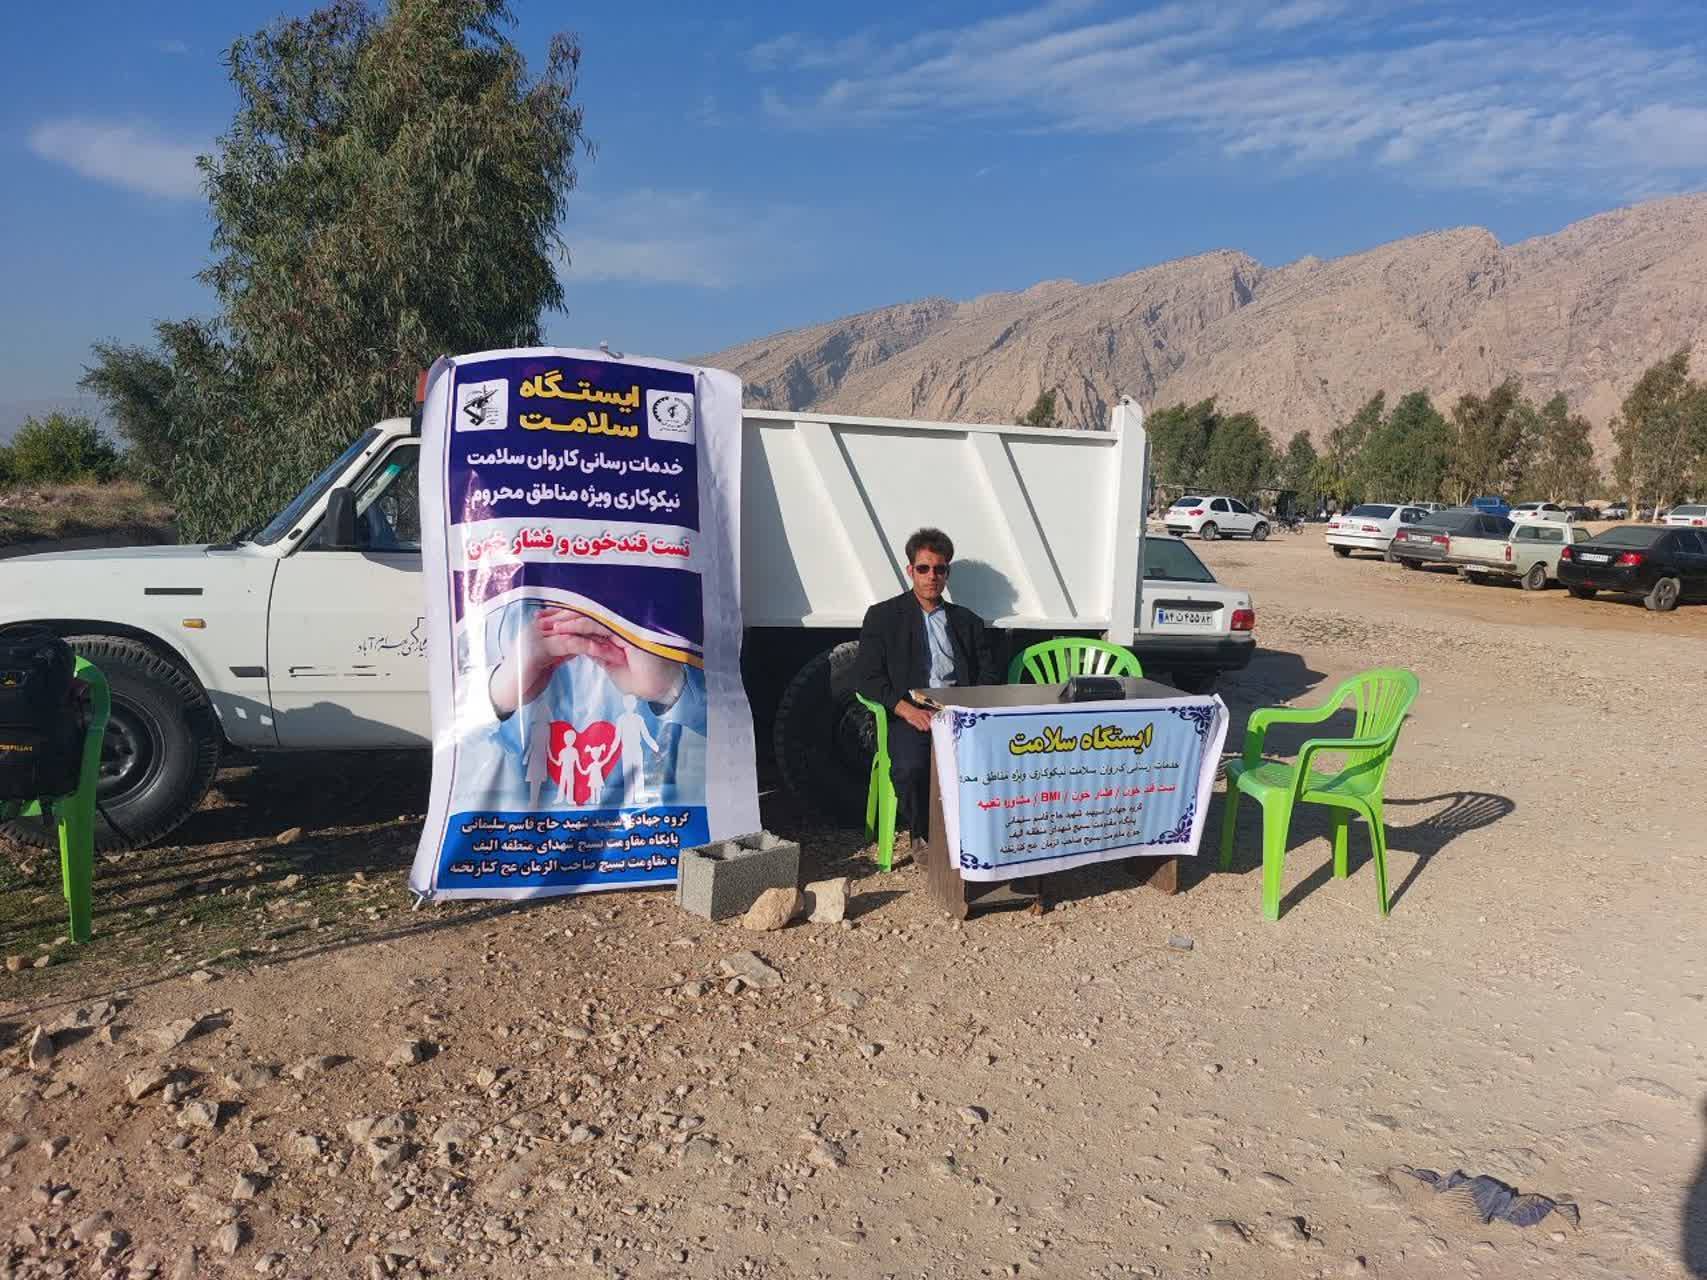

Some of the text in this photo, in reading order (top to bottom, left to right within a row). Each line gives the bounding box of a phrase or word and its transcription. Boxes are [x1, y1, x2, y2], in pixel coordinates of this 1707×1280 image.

[519, 370, 640, 415] ایستگاه
[519, 411, 639, 438] سلامت
[467, 448, 683, 476] خدمات رسانی کاروان سلامت
[471, 483, 681, 513] نیکوکاری ویژه مناطق محروم
[513, 528, 554, 555] فشار
[558, 538, 569, 555] و
[651, 540, 690, 560] تست
[1009, 723, 1153, 755] ایستگاه سلامت
[982, 770, 1009, 786] مناطق
[1011, 769, 1026, 783] ویژه
[1029, 766, 1066, 780] نیکوکاری
[1069, 766, 1097, 776] سلامت
[977, 797, 1000, 811] تغذیه
[1004, 794, 1031, 809] مشاوره
[1041, 791, 1061, 802] BMI
[461, 817, 506, 834] سلیمانی
[508, 817, 534, 833] قاسم
[537, 817, 560, 832] حاج
[563, 817, 589, 832] شهید
[663, 811, 689, 828] گروه
[472, 832, 679, 855] پایگاه مقاومت بسیج شهدای منطقه الیف
[500, 863, 518, 876] عج
[520, 859, 558, 876] الزمان
[560, 859, 596, 873] صاحب
[598, 859, 625, 873] بسیج
[627, 854, 667, 871] مقاومت
